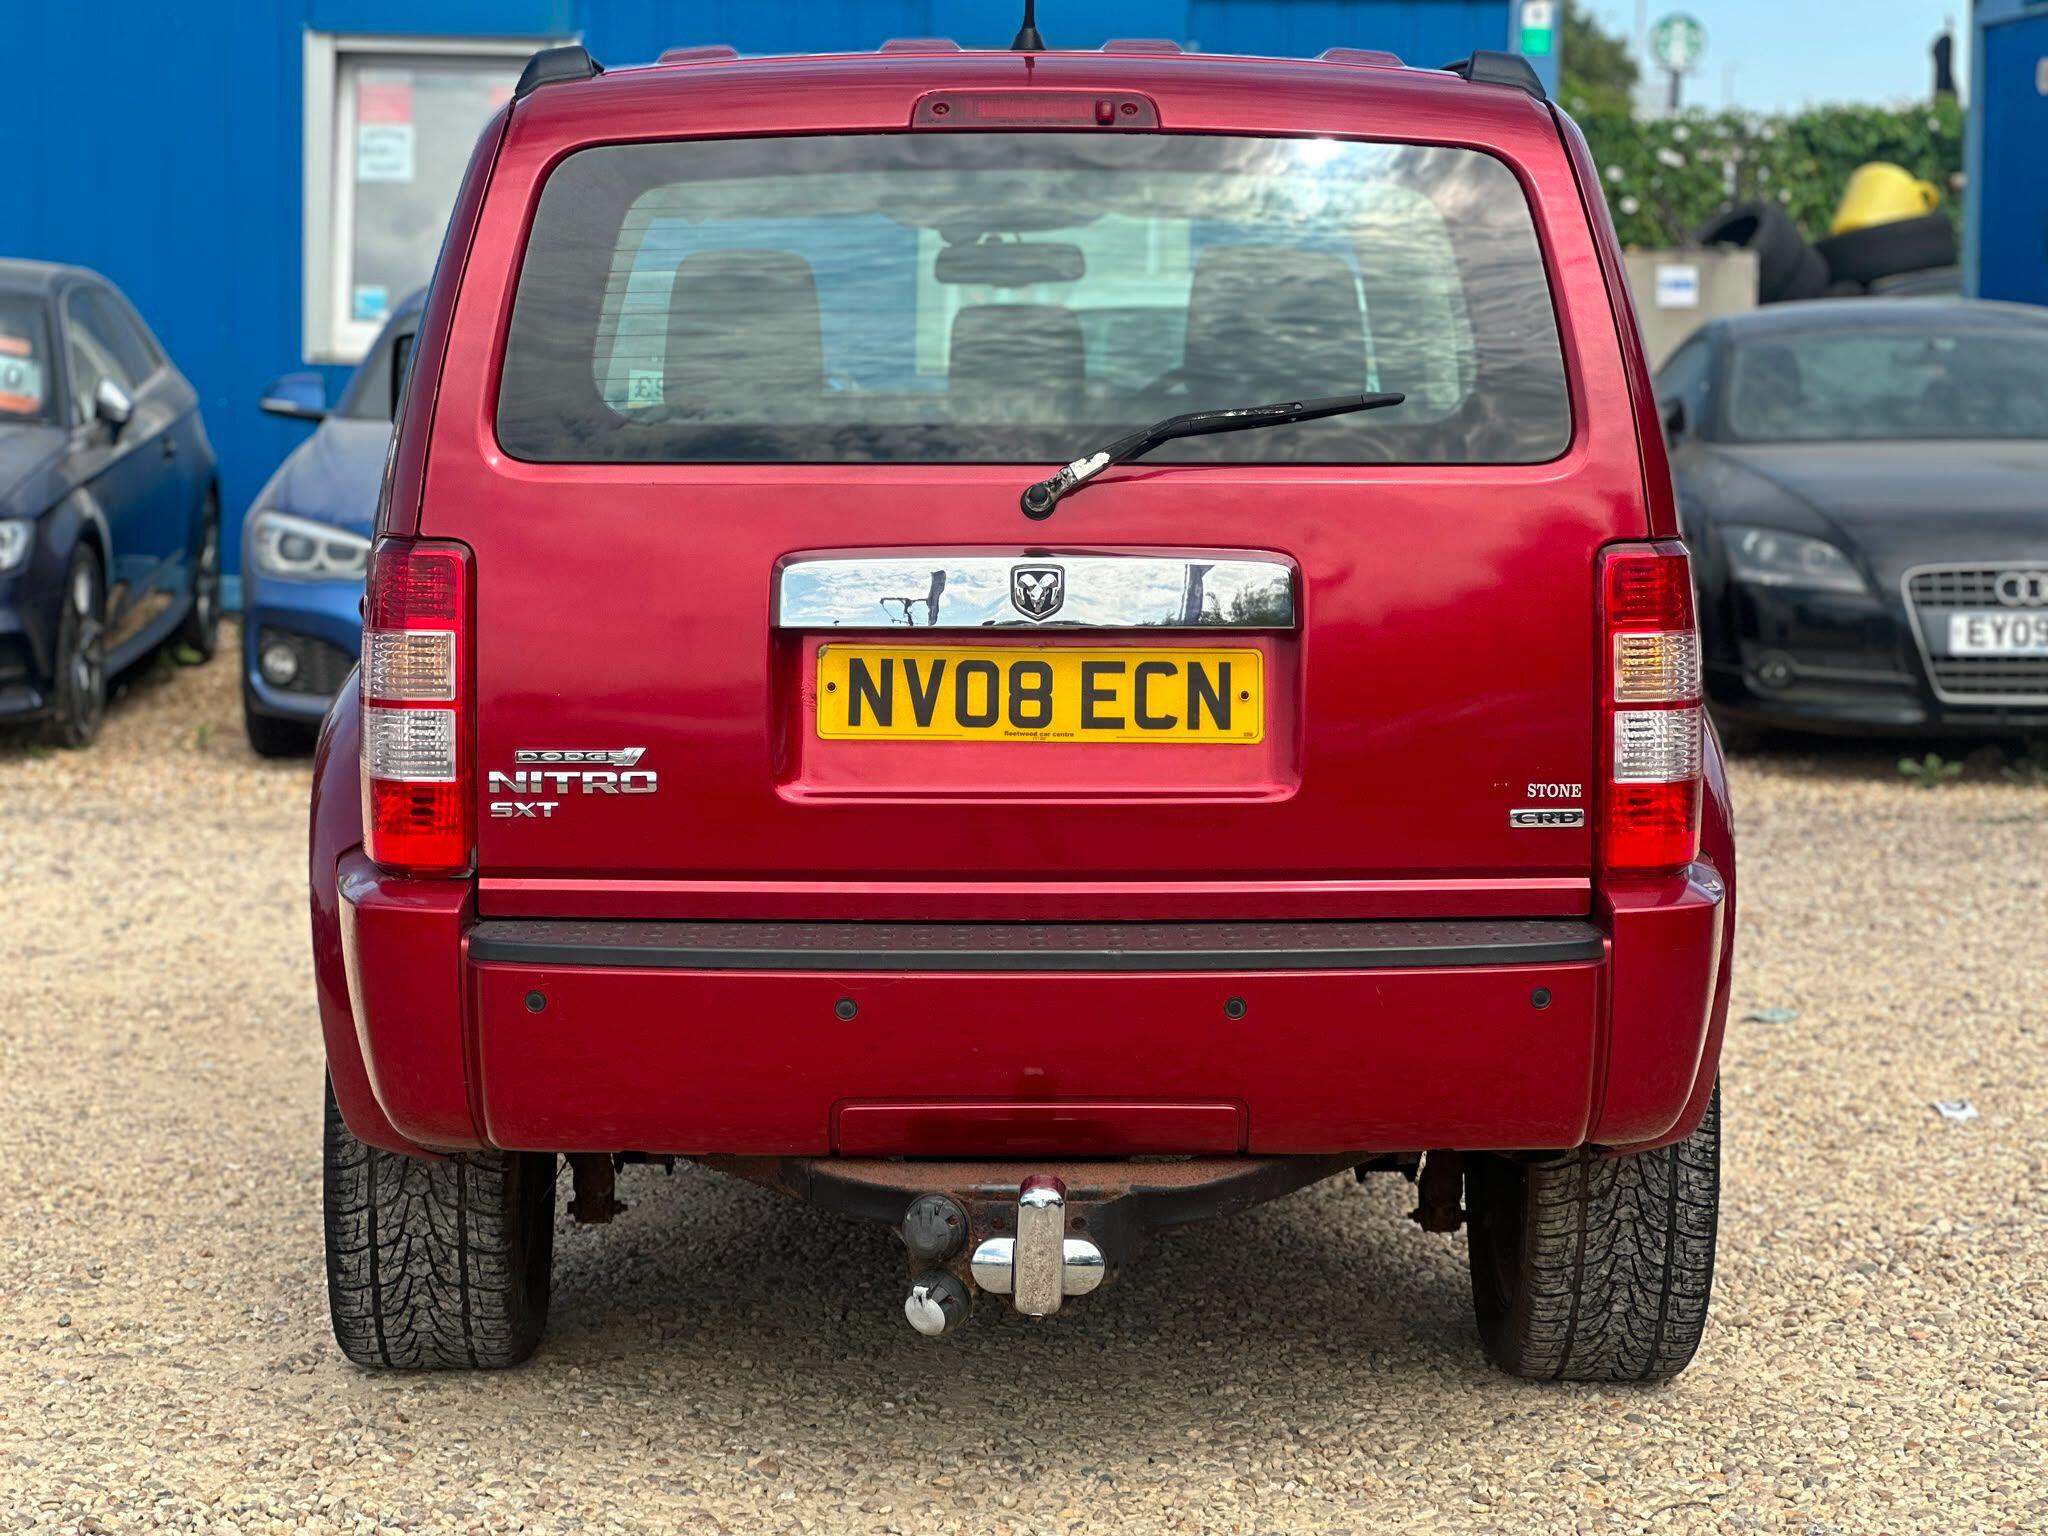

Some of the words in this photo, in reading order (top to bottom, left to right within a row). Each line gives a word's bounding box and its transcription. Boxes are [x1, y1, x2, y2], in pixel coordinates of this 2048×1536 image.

[848, 657, 1053, 729] NV08
[1081, 660, 1232, 731] ECN
[517, 751, 626, 762] DODGE
[489, 771, 658, 794] NITRO
[1527, 783, 1582, 798] STONE
[490, 802, 559, 818] SXT
[1514, 811, 1579, 825] CRD
